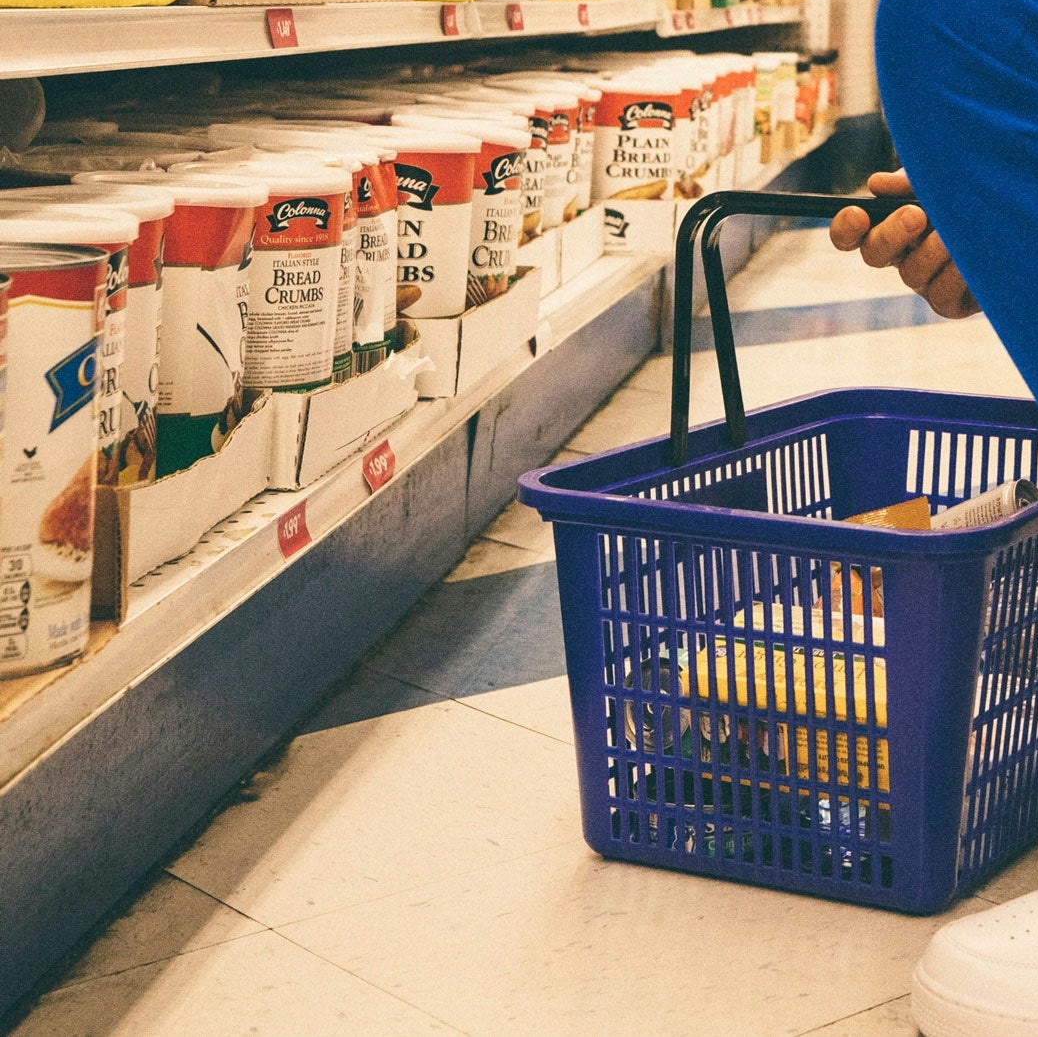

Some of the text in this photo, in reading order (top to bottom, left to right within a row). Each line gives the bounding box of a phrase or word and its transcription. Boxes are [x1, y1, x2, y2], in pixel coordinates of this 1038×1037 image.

[617, 134, 670, 149] PLAIN
[612, 149, 672, 164] BREAD
[276, 200, 327, 221] Colonna
[260, 234, 294, 245] Quality
[294, 235, 314, 243] since
[272, 257, 320, 268] ITALIAN STYLE
[272, 268, 322, 287] BREAD
[264, 286, 324, 305] CRUMBS
